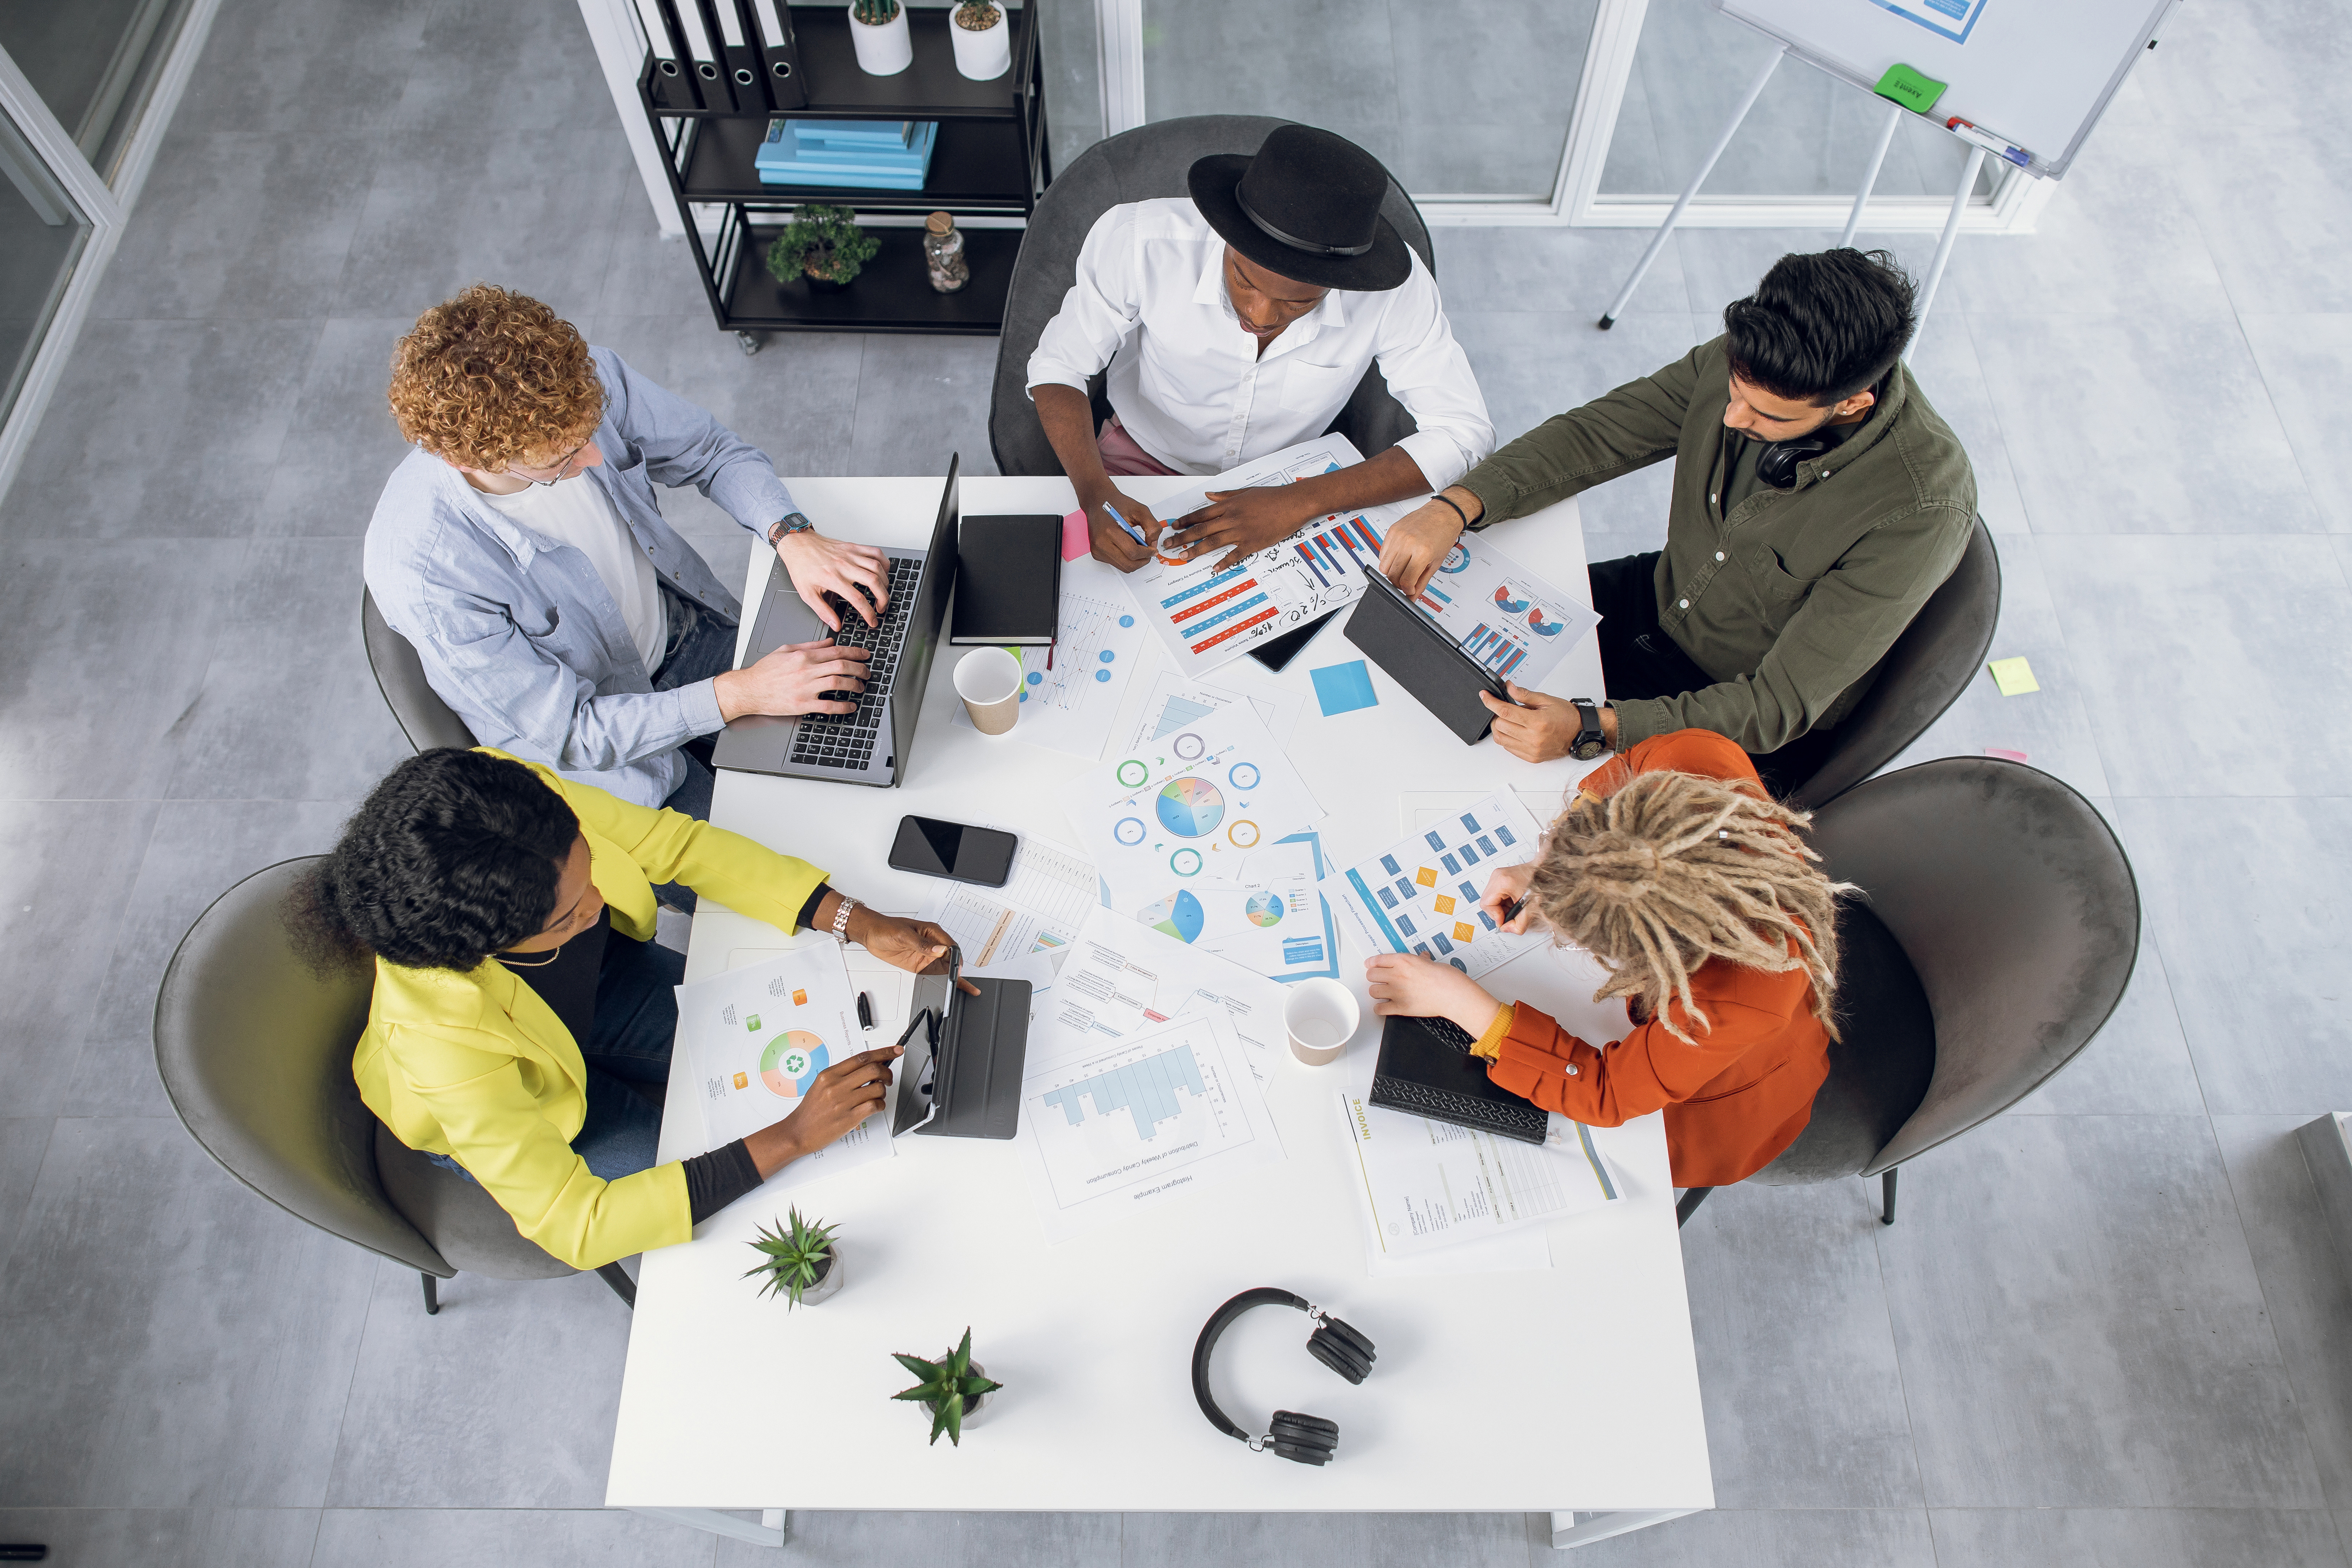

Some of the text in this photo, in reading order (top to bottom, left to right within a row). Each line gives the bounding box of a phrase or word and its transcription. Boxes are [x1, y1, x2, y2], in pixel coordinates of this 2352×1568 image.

[1192, 500, 1208, 512] Description
[1211, 547, 1228, 557] Description
[1145, 574, 1162, 584] Description
[1167, 577, 1184, 586] Category
[1224, 643, 1238, 652] Volume
[1001, 910, 1011, 924] Department
[1341, 893, 1377, 947] Repair Processing Flowchart
[839, 1011, 847, 1029] Business
[1147, 1012, 1162, 1020] Corporate
[1098, 1054, 1116, 1063] Consumed
[1217, 1082, 1226, 1103] Occurrences
[1352, 1098, 1371, 1140] INVOICE
[1167, 1141, 1198, 1155] Distribution
[1141, 1154, 1161, 1165] Weekly
[1122, 1161, 1140, 1172] Candy
[1086, 1168, 1122, 1184] Consumption
[1133, 1175, 1193, 1200] Histogram Example
[1404, 1196, 1419, 1236] [Company Name]
